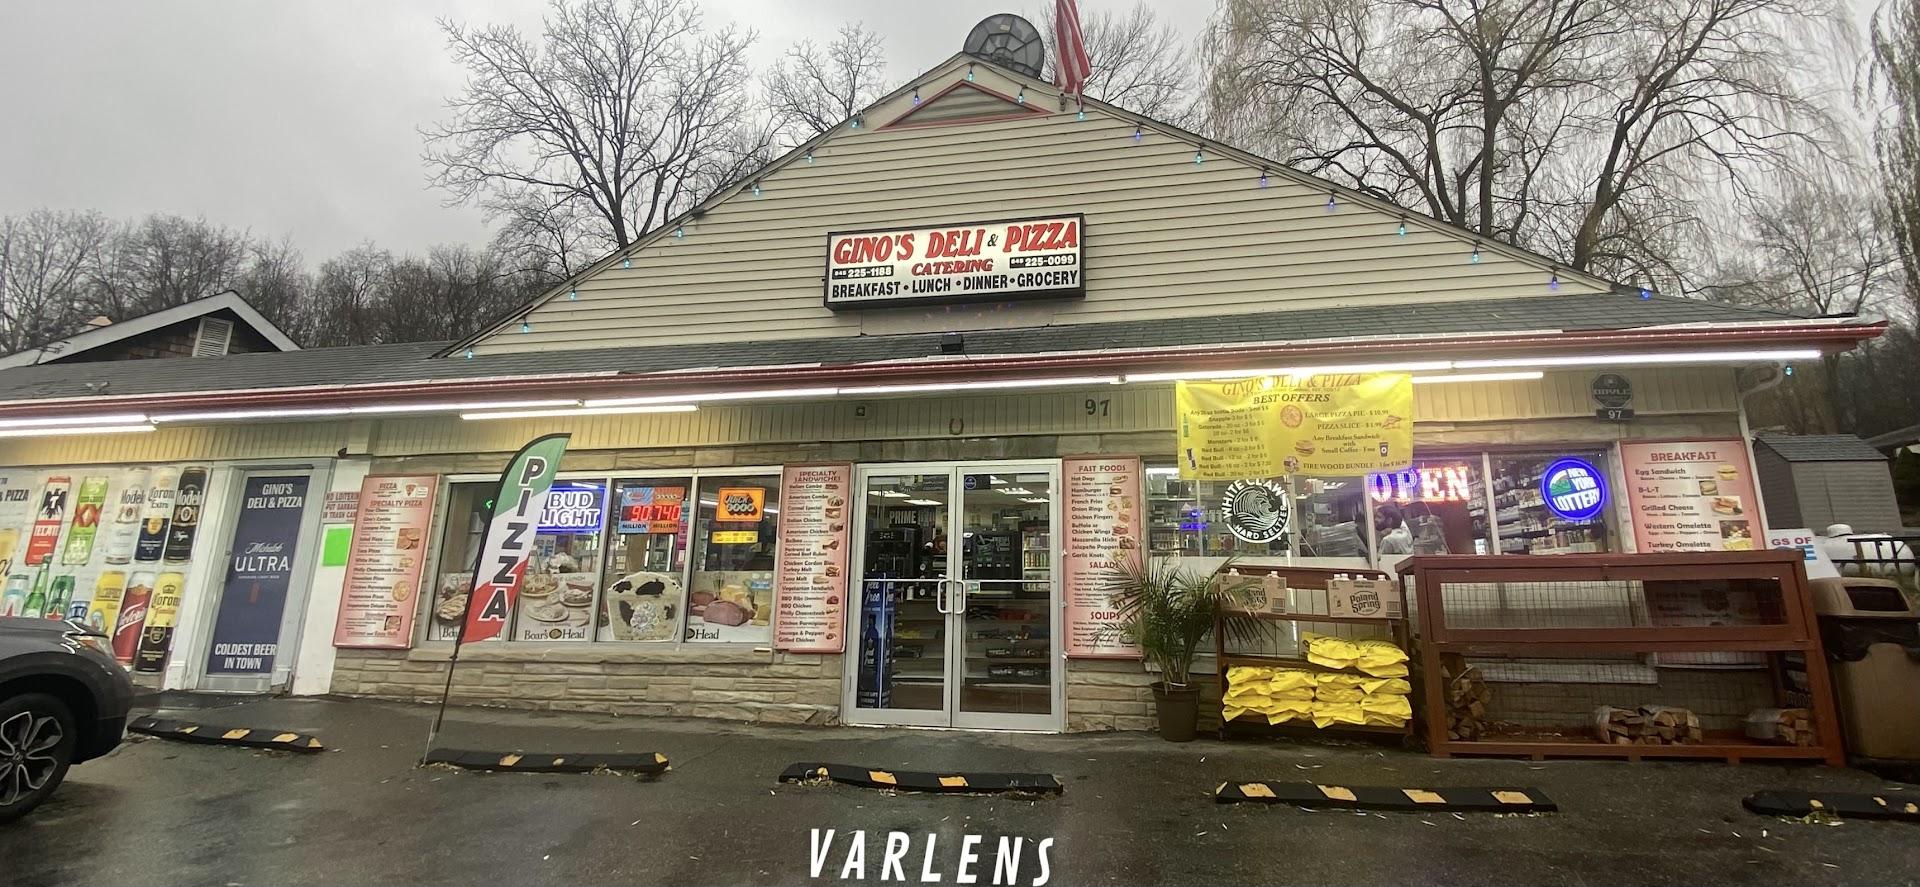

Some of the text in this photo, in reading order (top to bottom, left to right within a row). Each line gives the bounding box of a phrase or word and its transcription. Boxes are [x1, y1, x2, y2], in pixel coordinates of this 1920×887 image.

[834, 222, 1078, 264] GINO'S DELI & PIZZA
[911, 259, 993, 276] CATERING
[1025, 256, 1073, 266] 225-0099
[848, 266, 892, 278] 225-1188
[832, 270, 1078, 298] BREAKFAST LUNCH DINNER GROCERY
[1307, 376, 1317, 387] &
[1322, 374, 1360, 388] PIZZA
[1253, 393, 1331, 405] BEST OFFERS
[1085, 399, 1110, 417] 97
[1608, 410, 1622, 419] 97
[1650, 451, 1717, 462] BREAKFAST
[1566, 468, 1589, 478] NEW
[262, 483, 293, 495] GINO'S
[1368, 466, 1471, 503] OPEN
[1572, 476, 1598, 491] YORK
[5, 489, 29, 501] PIZZA
[548, 491, 593, 509] BUD
[1222, 478, 1285, 519] WHITE CLAW
[1552, 488, 1601, 512] LOTTERY
[248, 497, 302, 508] DELI & PIZZA
[538, 508, 600, 527] LIGHT
[889, 510, 916, 524] PRIME
[1234, 505, 1287, 539] HARD SELTZER
[478, 456, 547, 621] PIZZA
[235, 556, 289, 571] ULTRA
[1349, 591, 1379, 605] Poland
[1351, 600, 1381, 614] Spring
[524, 628, 585, 640] Boar's Head
[696, 628, 720, 640] Head
[215, 643, 276, 655] COLDEST BEER
[224, 657, 262, 669] IN TOWN
